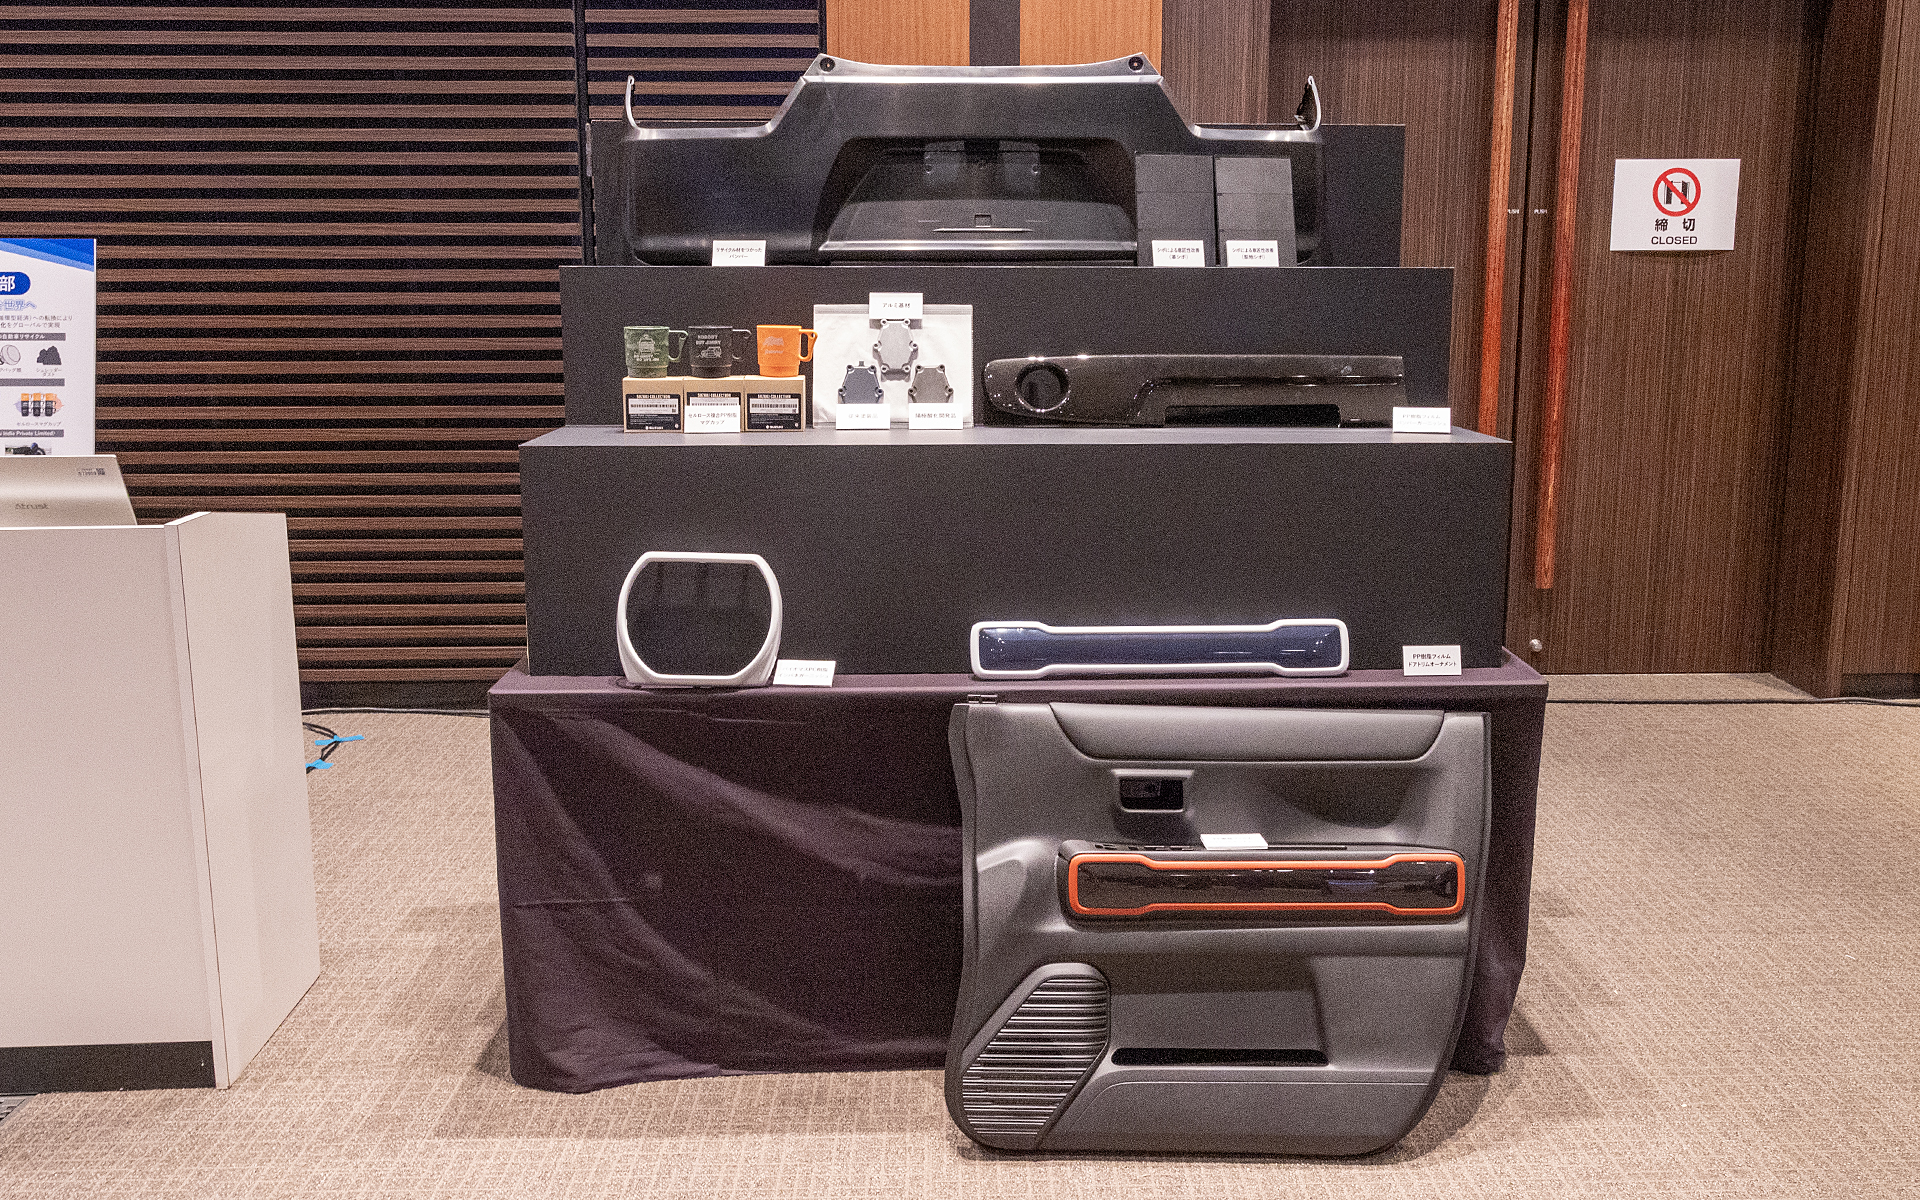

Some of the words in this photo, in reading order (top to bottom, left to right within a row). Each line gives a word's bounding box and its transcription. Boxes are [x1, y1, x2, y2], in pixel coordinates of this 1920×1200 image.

[1654, 217, 1696, 232] 締切
[1650, 235, 1698, 245] CLOSED
[0, 275, 16, 292] 部
